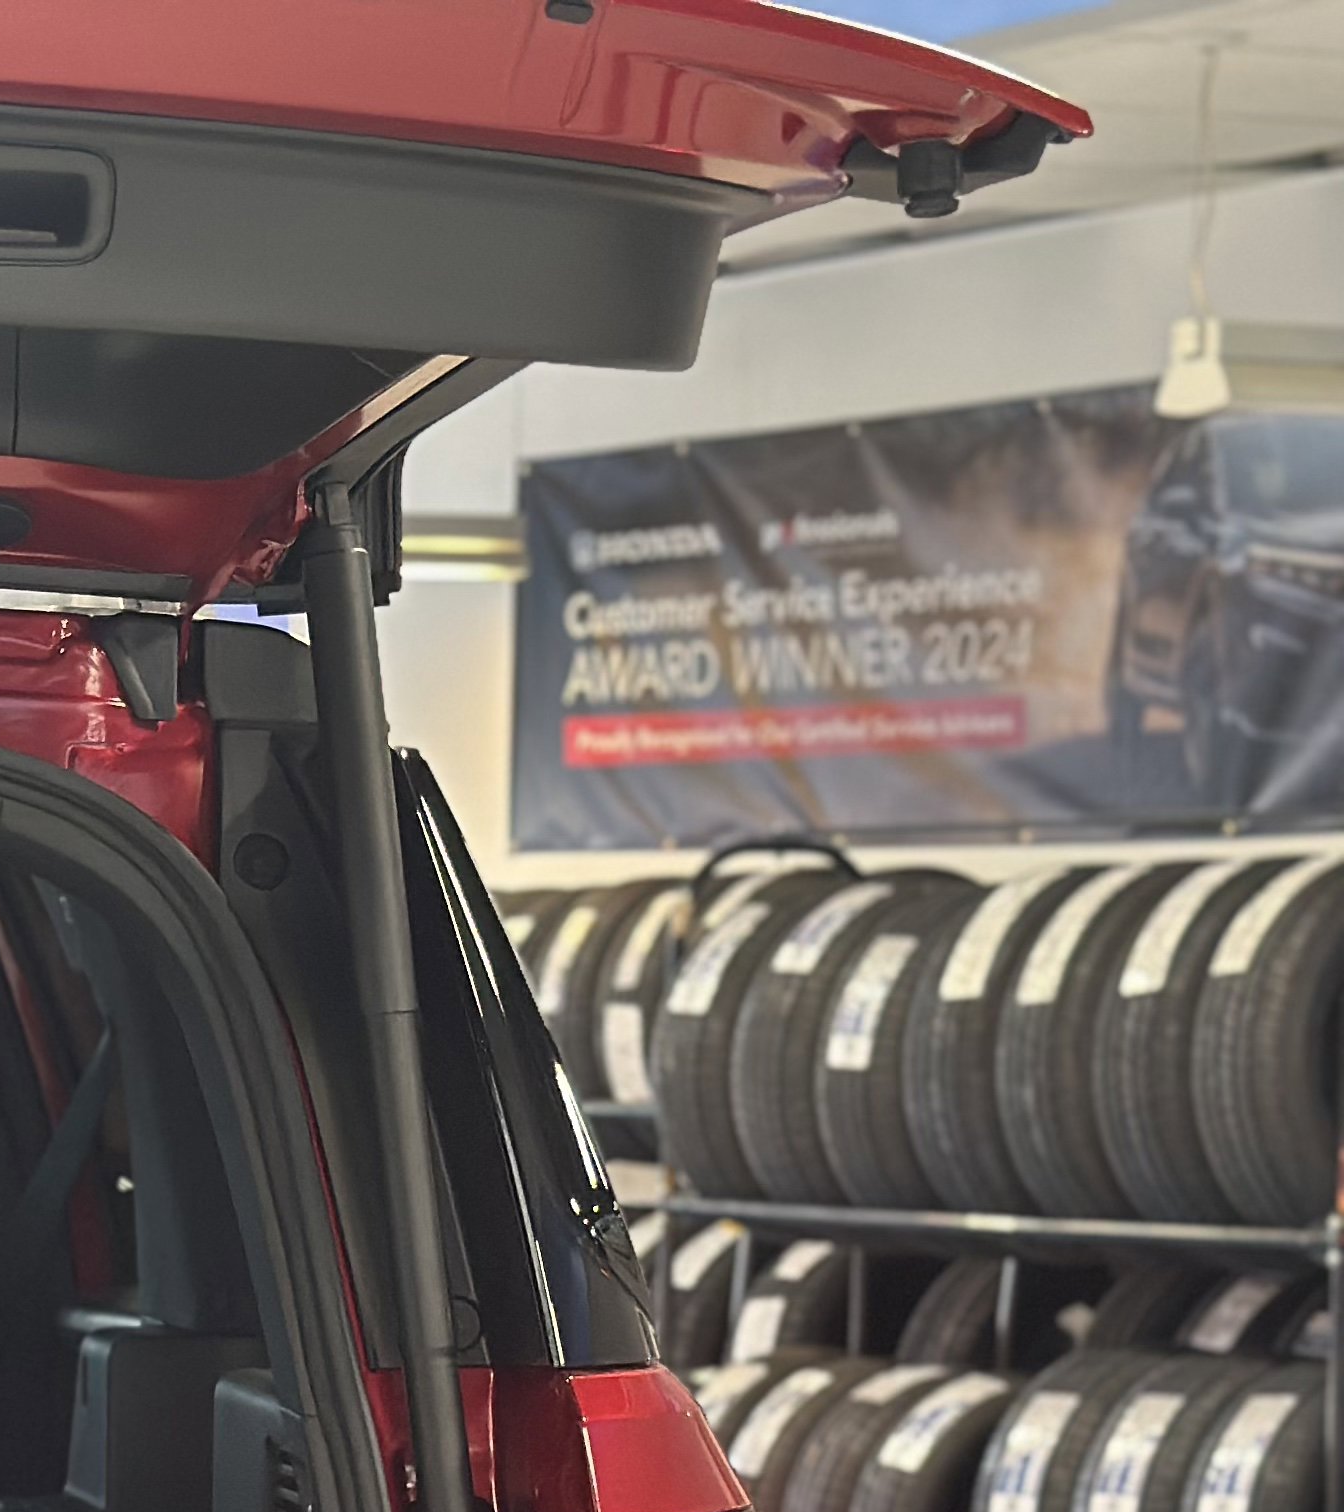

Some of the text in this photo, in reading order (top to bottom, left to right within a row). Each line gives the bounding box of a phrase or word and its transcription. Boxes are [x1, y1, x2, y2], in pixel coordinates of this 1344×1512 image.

[597, 523, 723, 567] HONDA
[564, 561, 1042, 641] Customer Service Experience
[562, 617, 1034, 707] AWARD WINNER 2024
